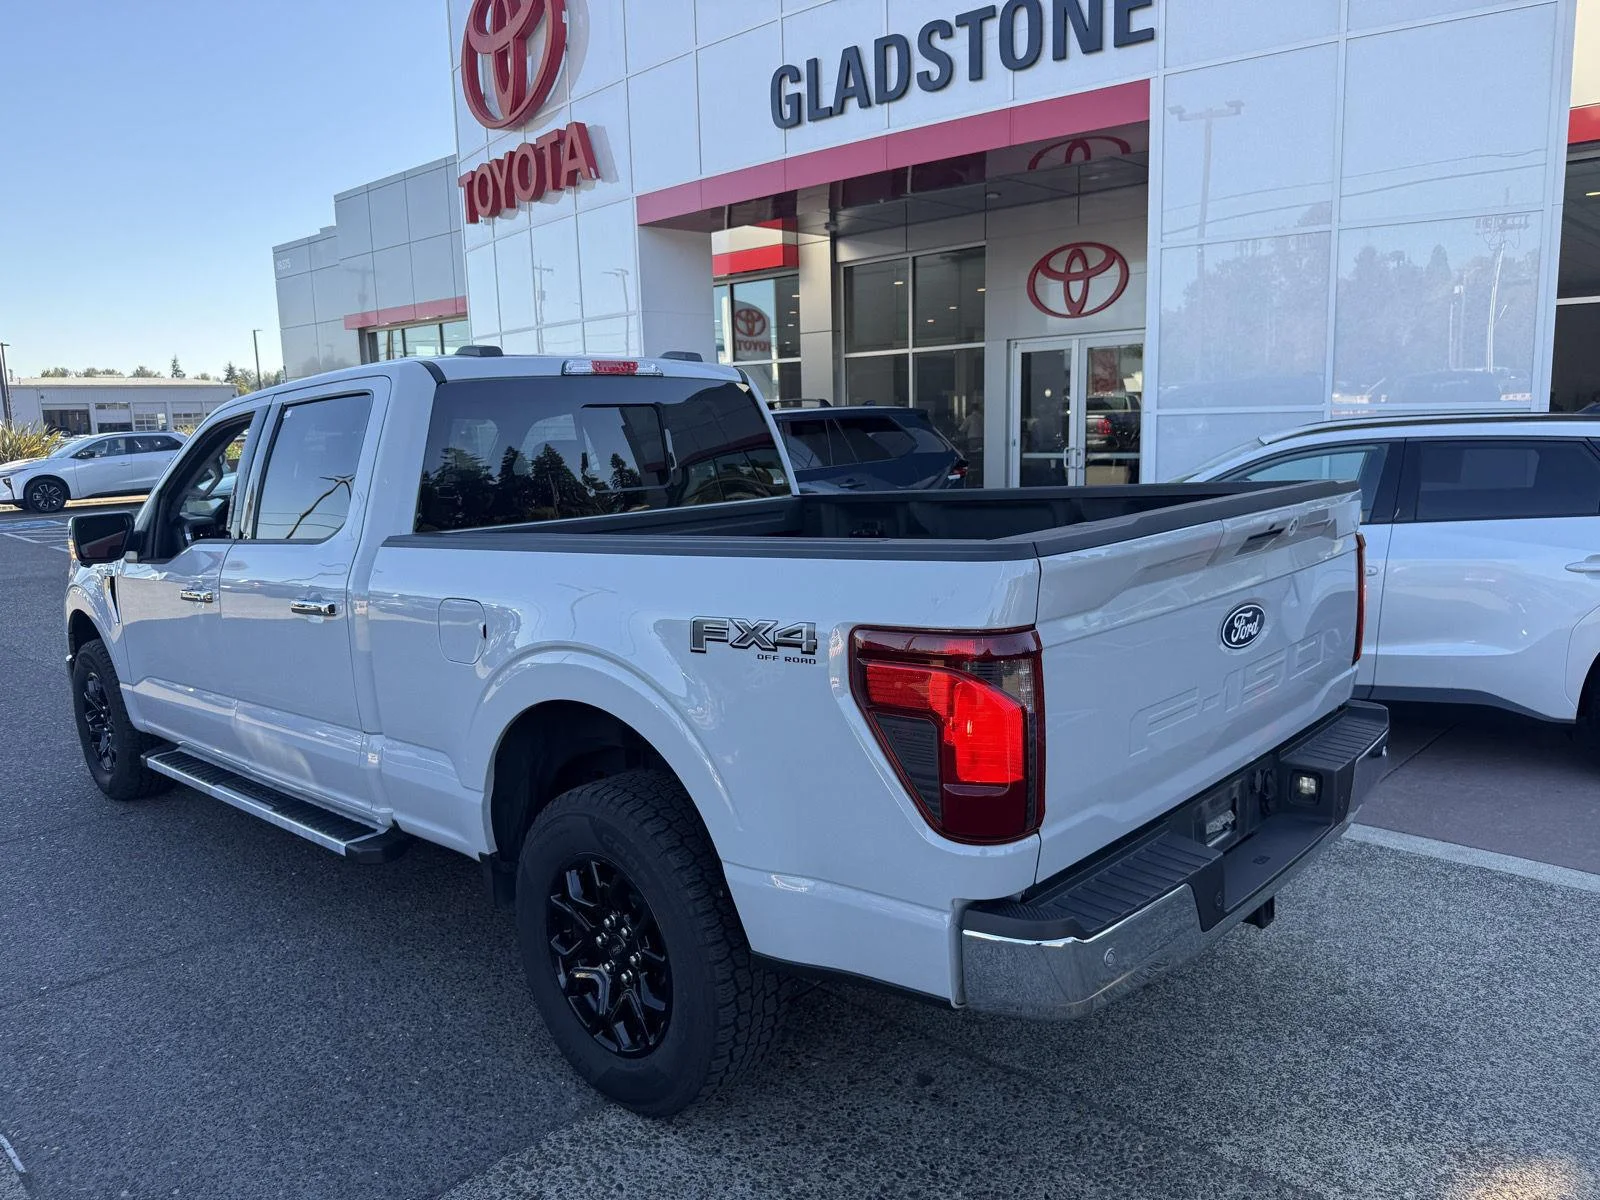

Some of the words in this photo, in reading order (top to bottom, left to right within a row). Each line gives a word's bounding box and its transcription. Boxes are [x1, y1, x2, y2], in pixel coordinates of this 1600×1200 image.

[770, 0, 1155, 130] GLADSTONE
[457, 121, 602, 225] TOYOTA
[690, 615, 818, 655] FX4
[1231, 610, 1260, 643] Ford
[757, 653, 780, 662] OFF
[784, 656, 817, 665] ROAD
